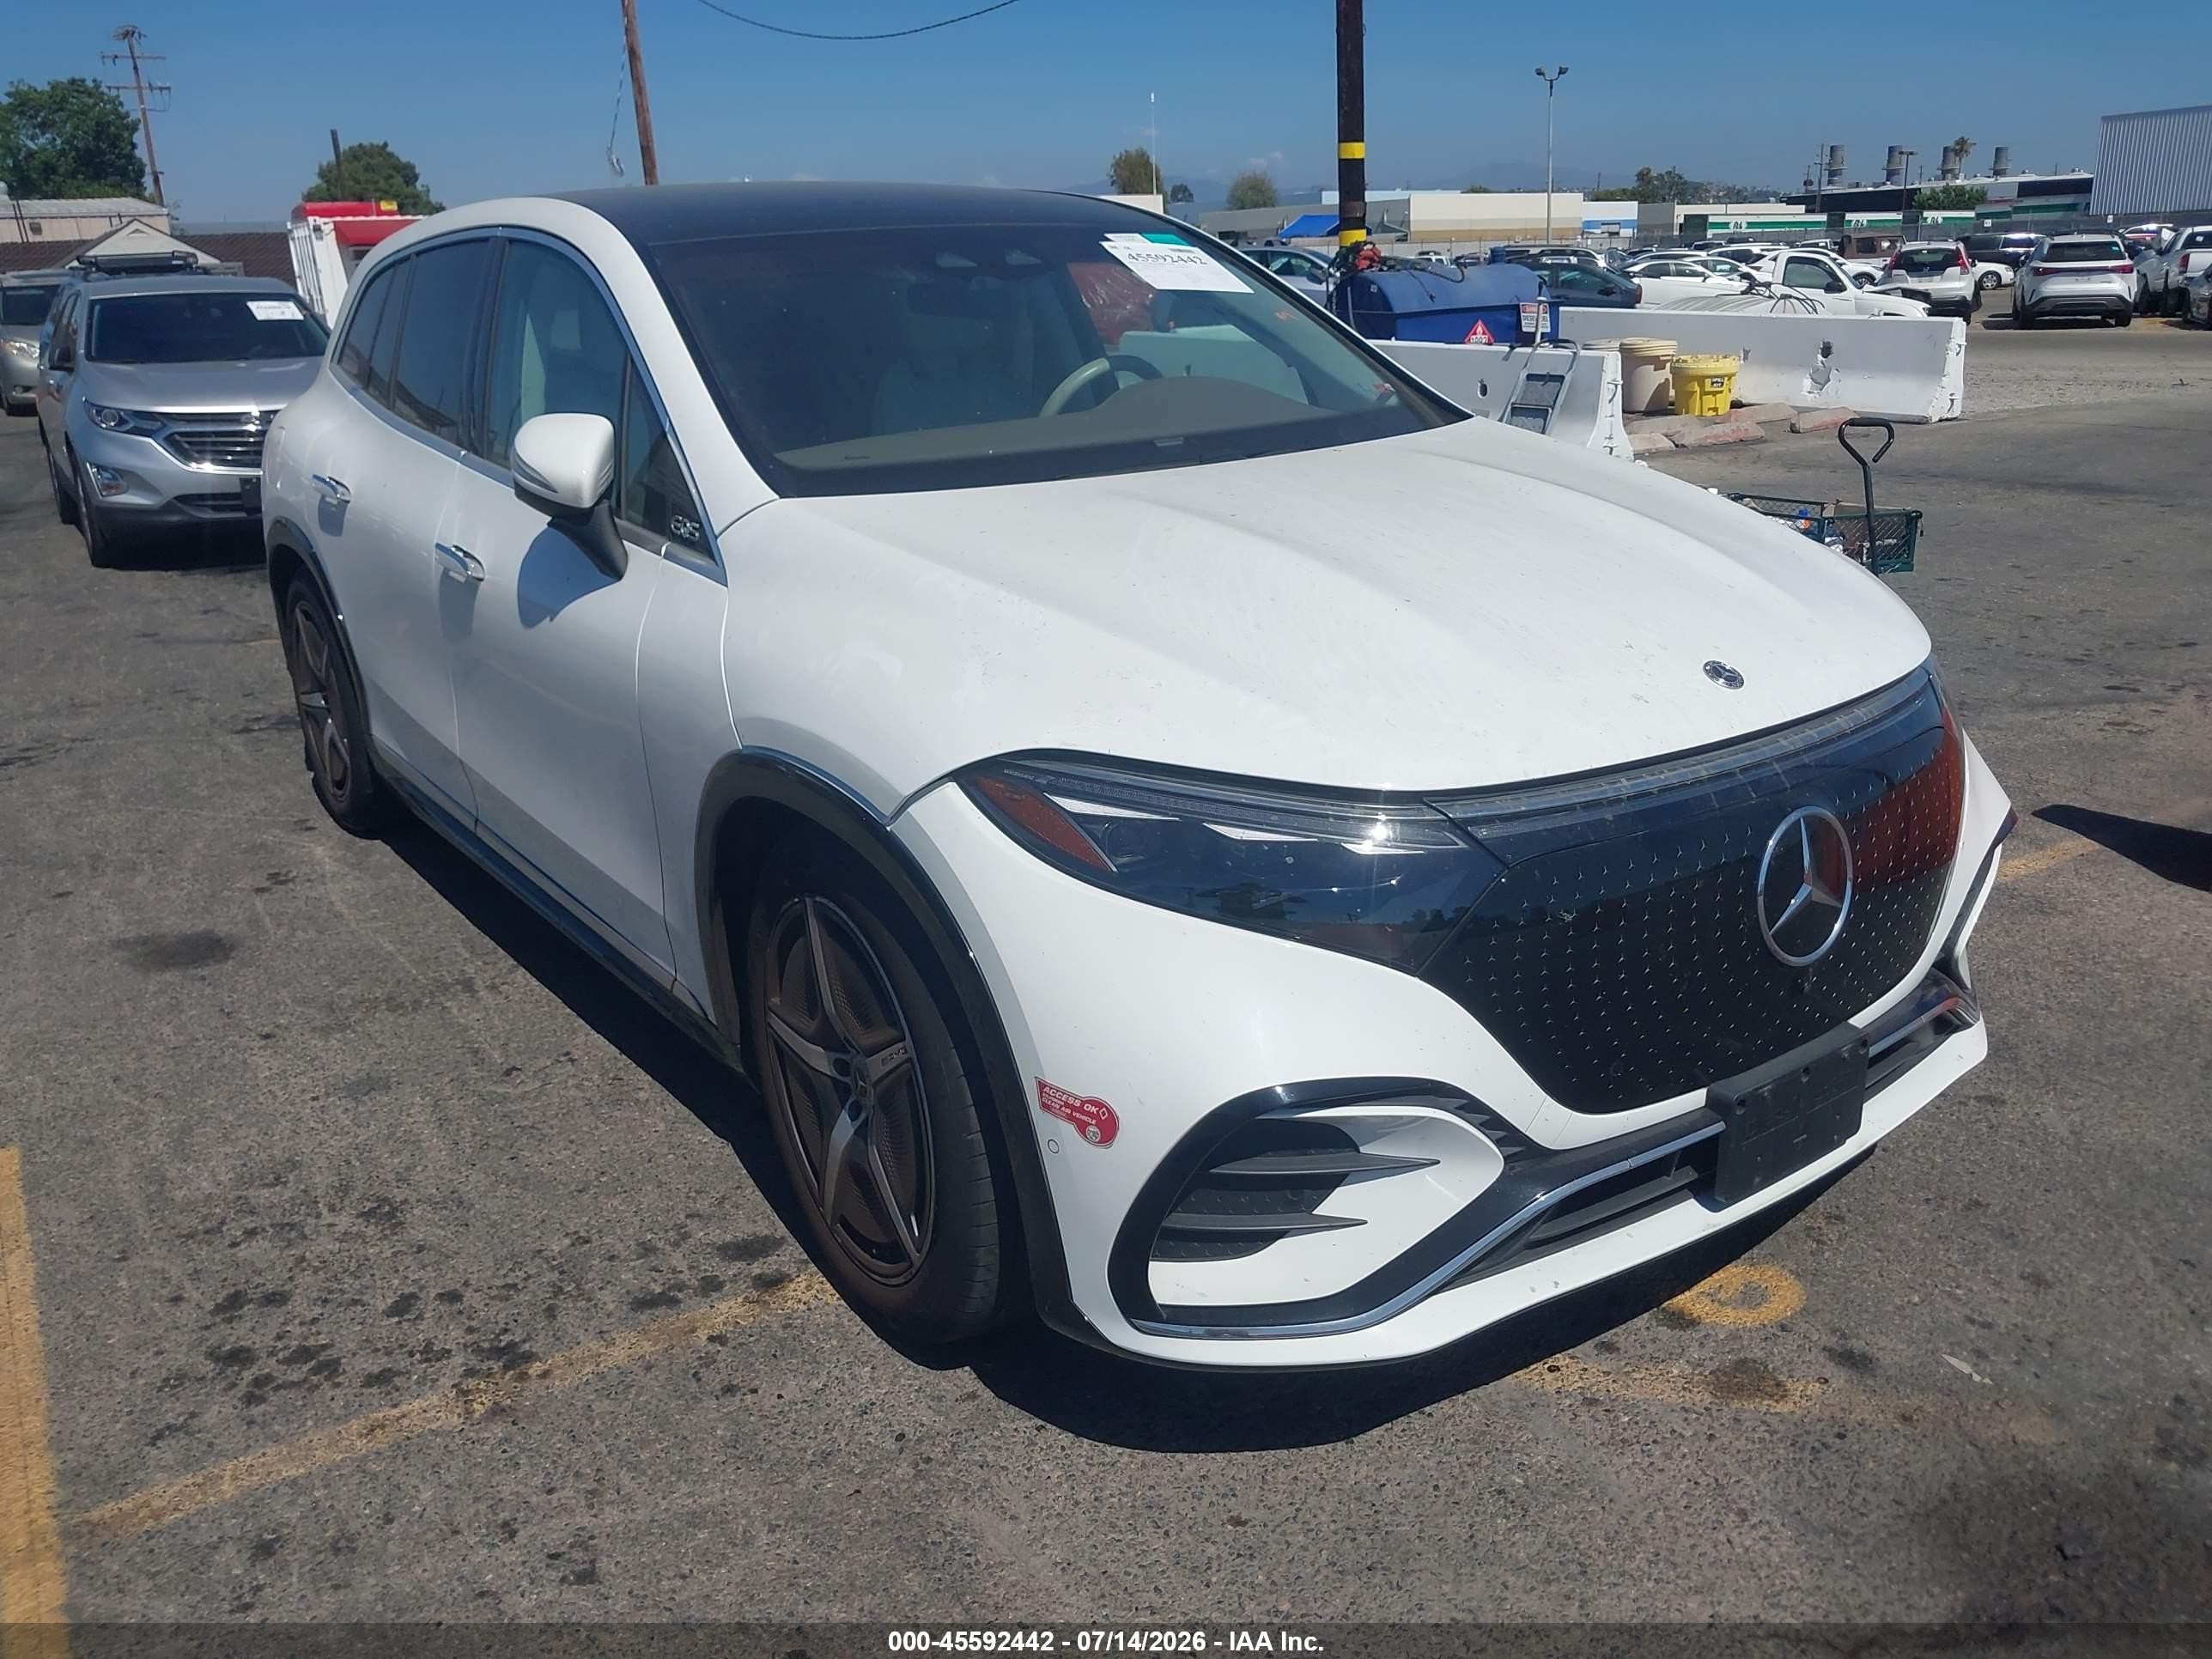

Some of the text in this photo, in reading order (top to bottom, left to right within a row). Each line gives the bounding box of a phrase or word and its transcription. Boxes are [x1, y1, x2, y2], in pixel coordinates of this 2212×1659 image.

[1127, 252, 1208, 265] 45592442
[1042, 1086, 1082, 1107] ACCESS
[1084, 1103, 1100, 1115] OK
[1042, 1097, 1060, 1109] CLEAN
[1073, 1111, 1097, 1125] VEHICLE
